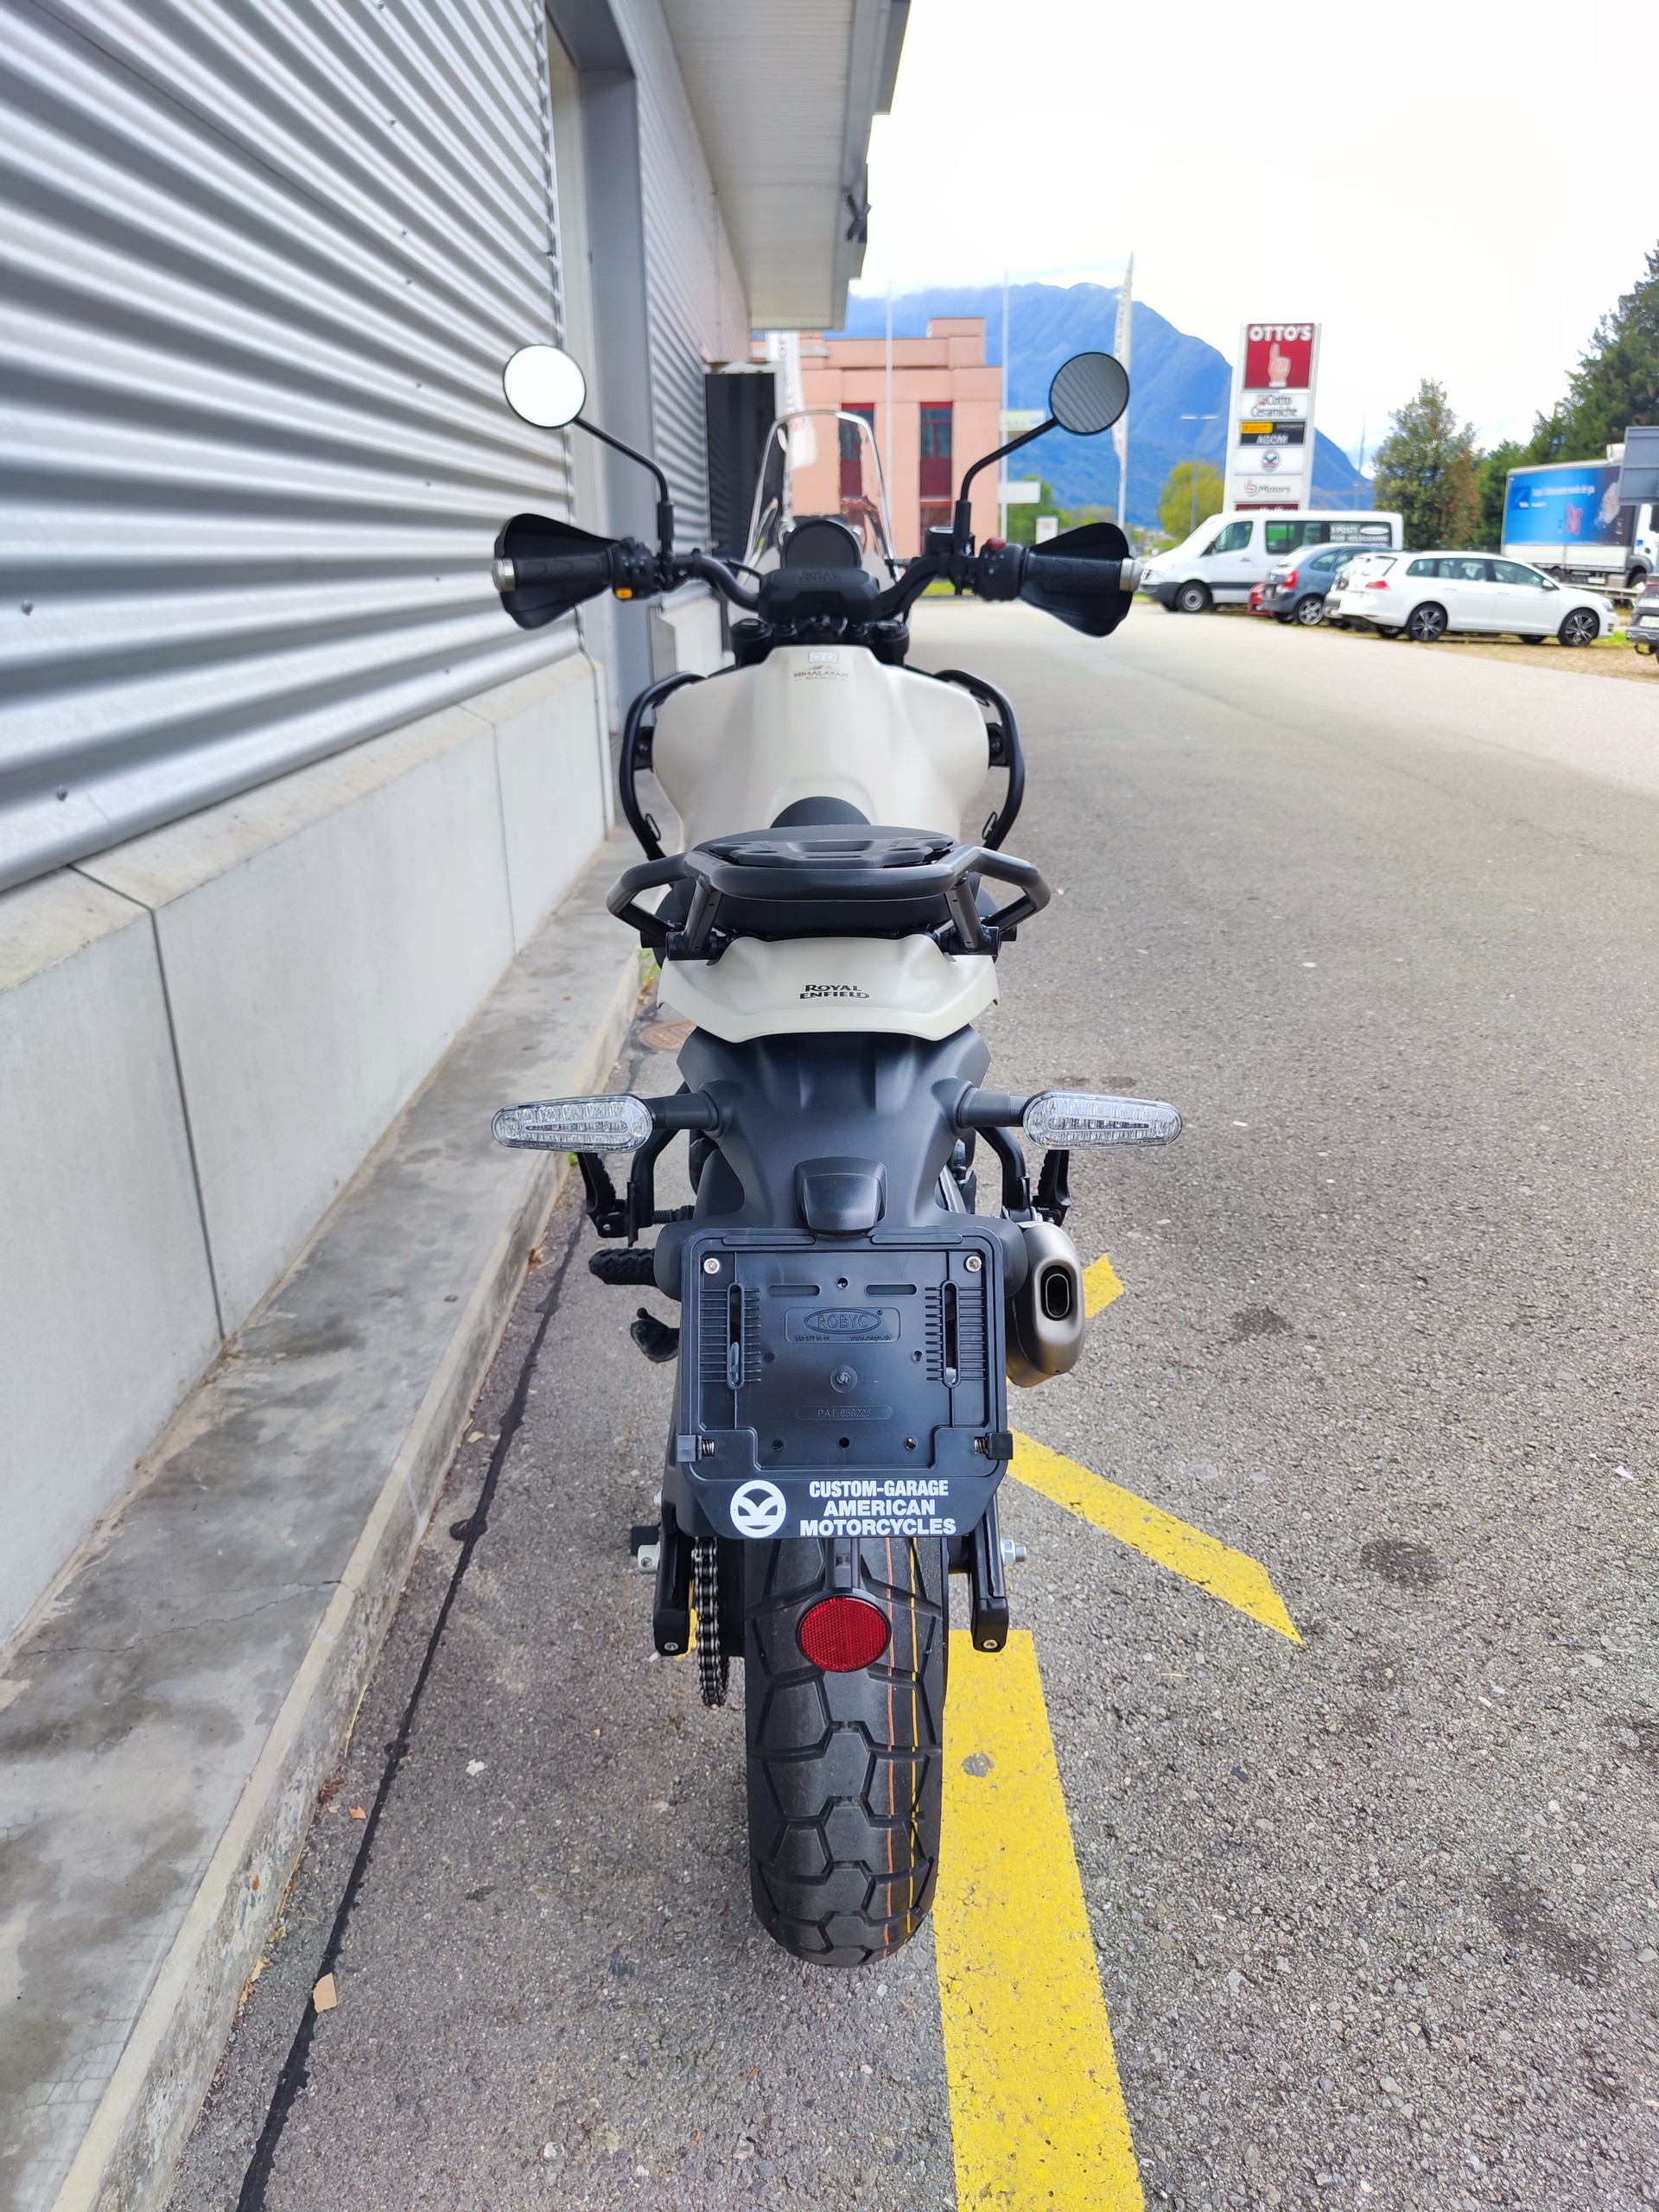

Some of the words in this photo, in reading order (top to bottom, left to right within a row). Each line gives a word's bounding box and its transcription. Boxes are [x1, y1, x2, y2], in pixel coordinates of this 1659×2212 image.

[1249, 325, 1313, 342] OTTO'S
[799, 991, 870, 1000] ENFIELD
[817, 1314, 869, 1329] ROBYC
[809, 1479, 950, 1498] CUSTOM-GARAGE
[823, 1499, 936, 1517] AMERICAN
[799, 1518, 957, 1536] MOTORCYCLES
